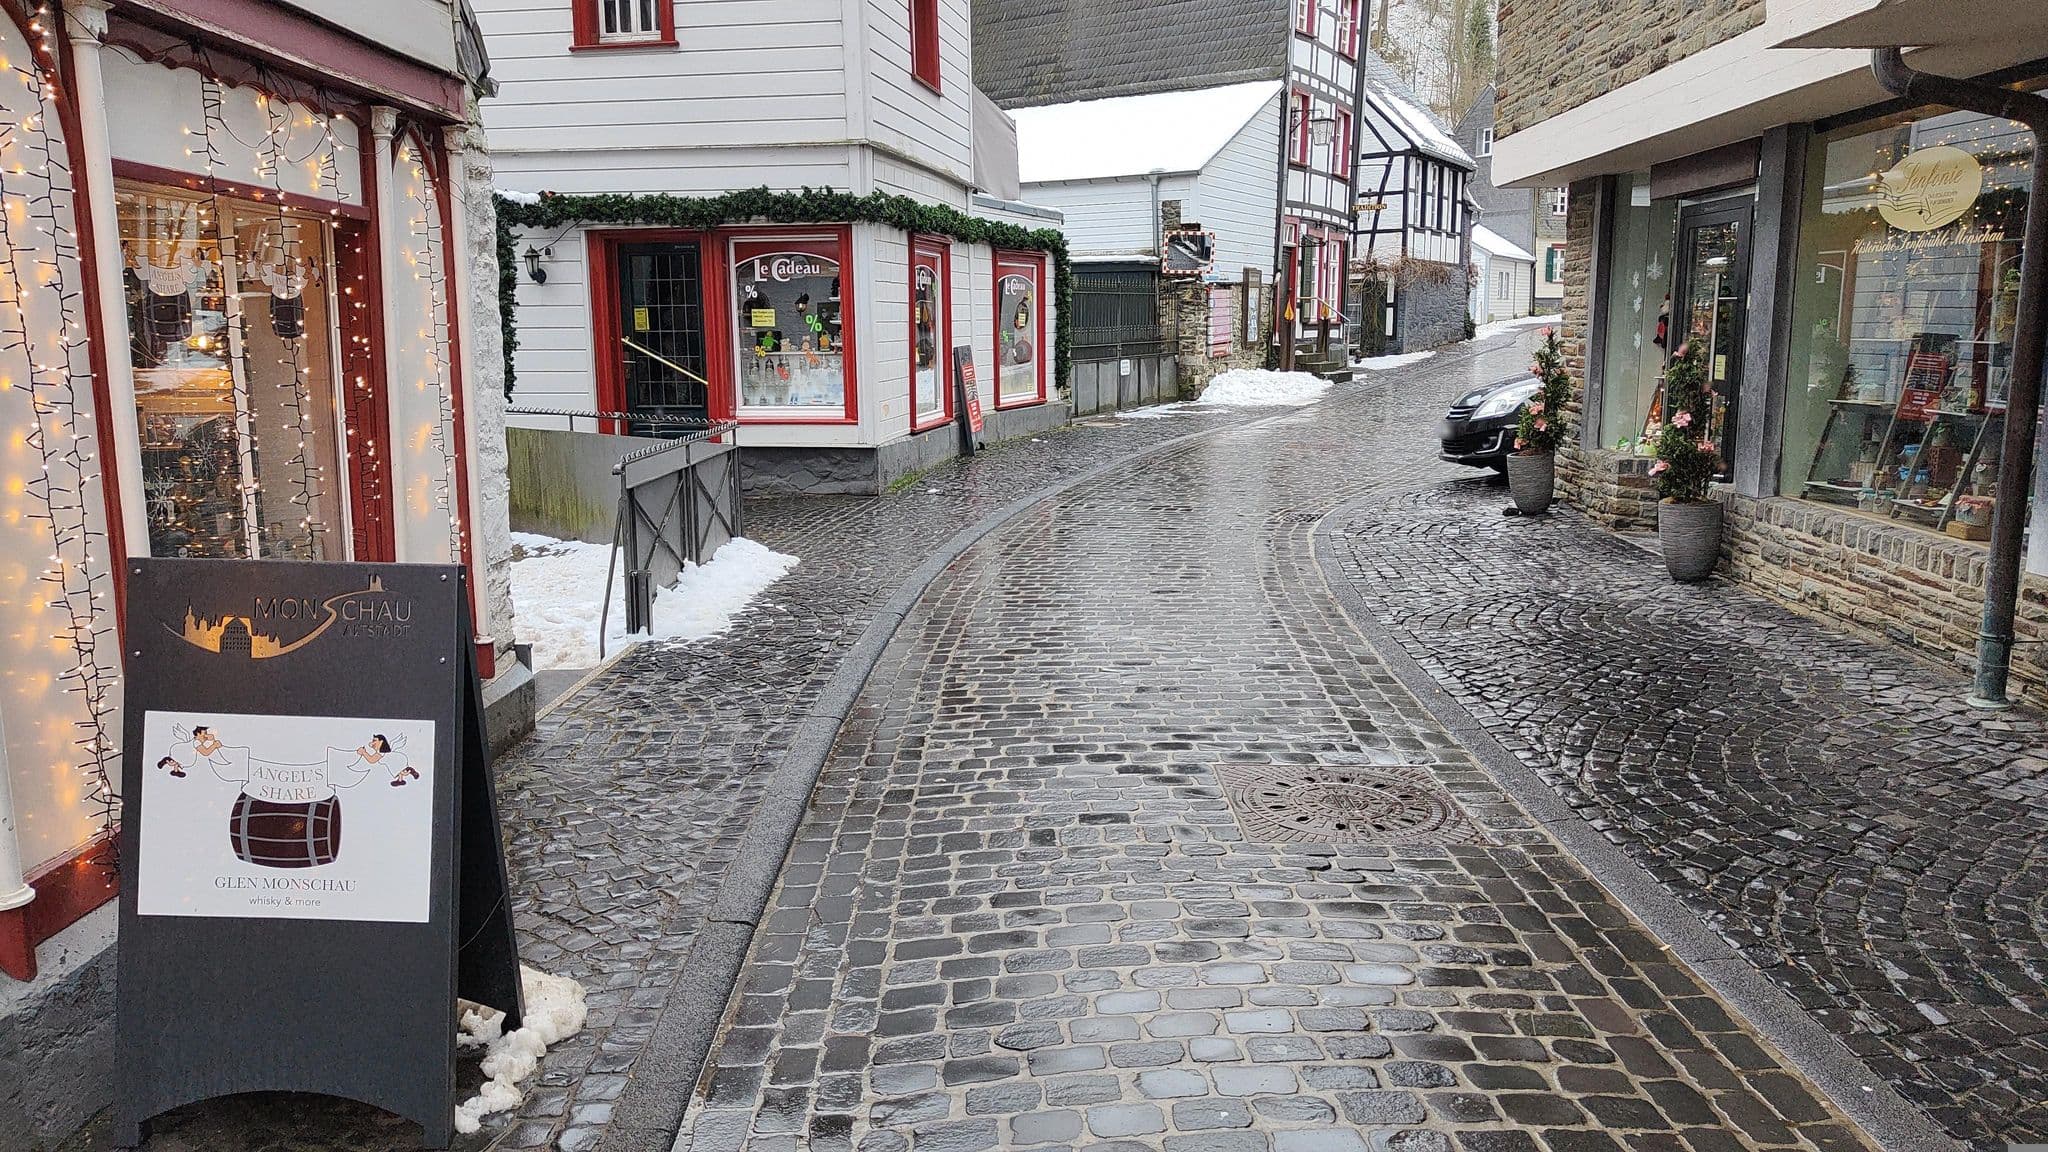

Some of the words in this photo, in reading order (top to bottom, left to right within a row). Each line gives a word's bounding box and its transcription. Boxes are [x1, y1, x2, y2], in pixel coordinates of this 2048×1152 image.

[1896, 160, 1965, 196] Senfonie
[754, 259, 769, 282] Le
[771, 258, 820, 282] Cadeau
[253, 597, 411, 622] MONSCHAU
[253, 766, 324, 783] ANGEL'S
[260, 785, 317, 801] SHARE
[214, 876, 258, 889] GLEN
[262, 877, 356, 892] MONSCHAU
[249, 896, 281, 908] whisky
[284, 897, 292, 906] &
[295, 899, 321, 907] more
